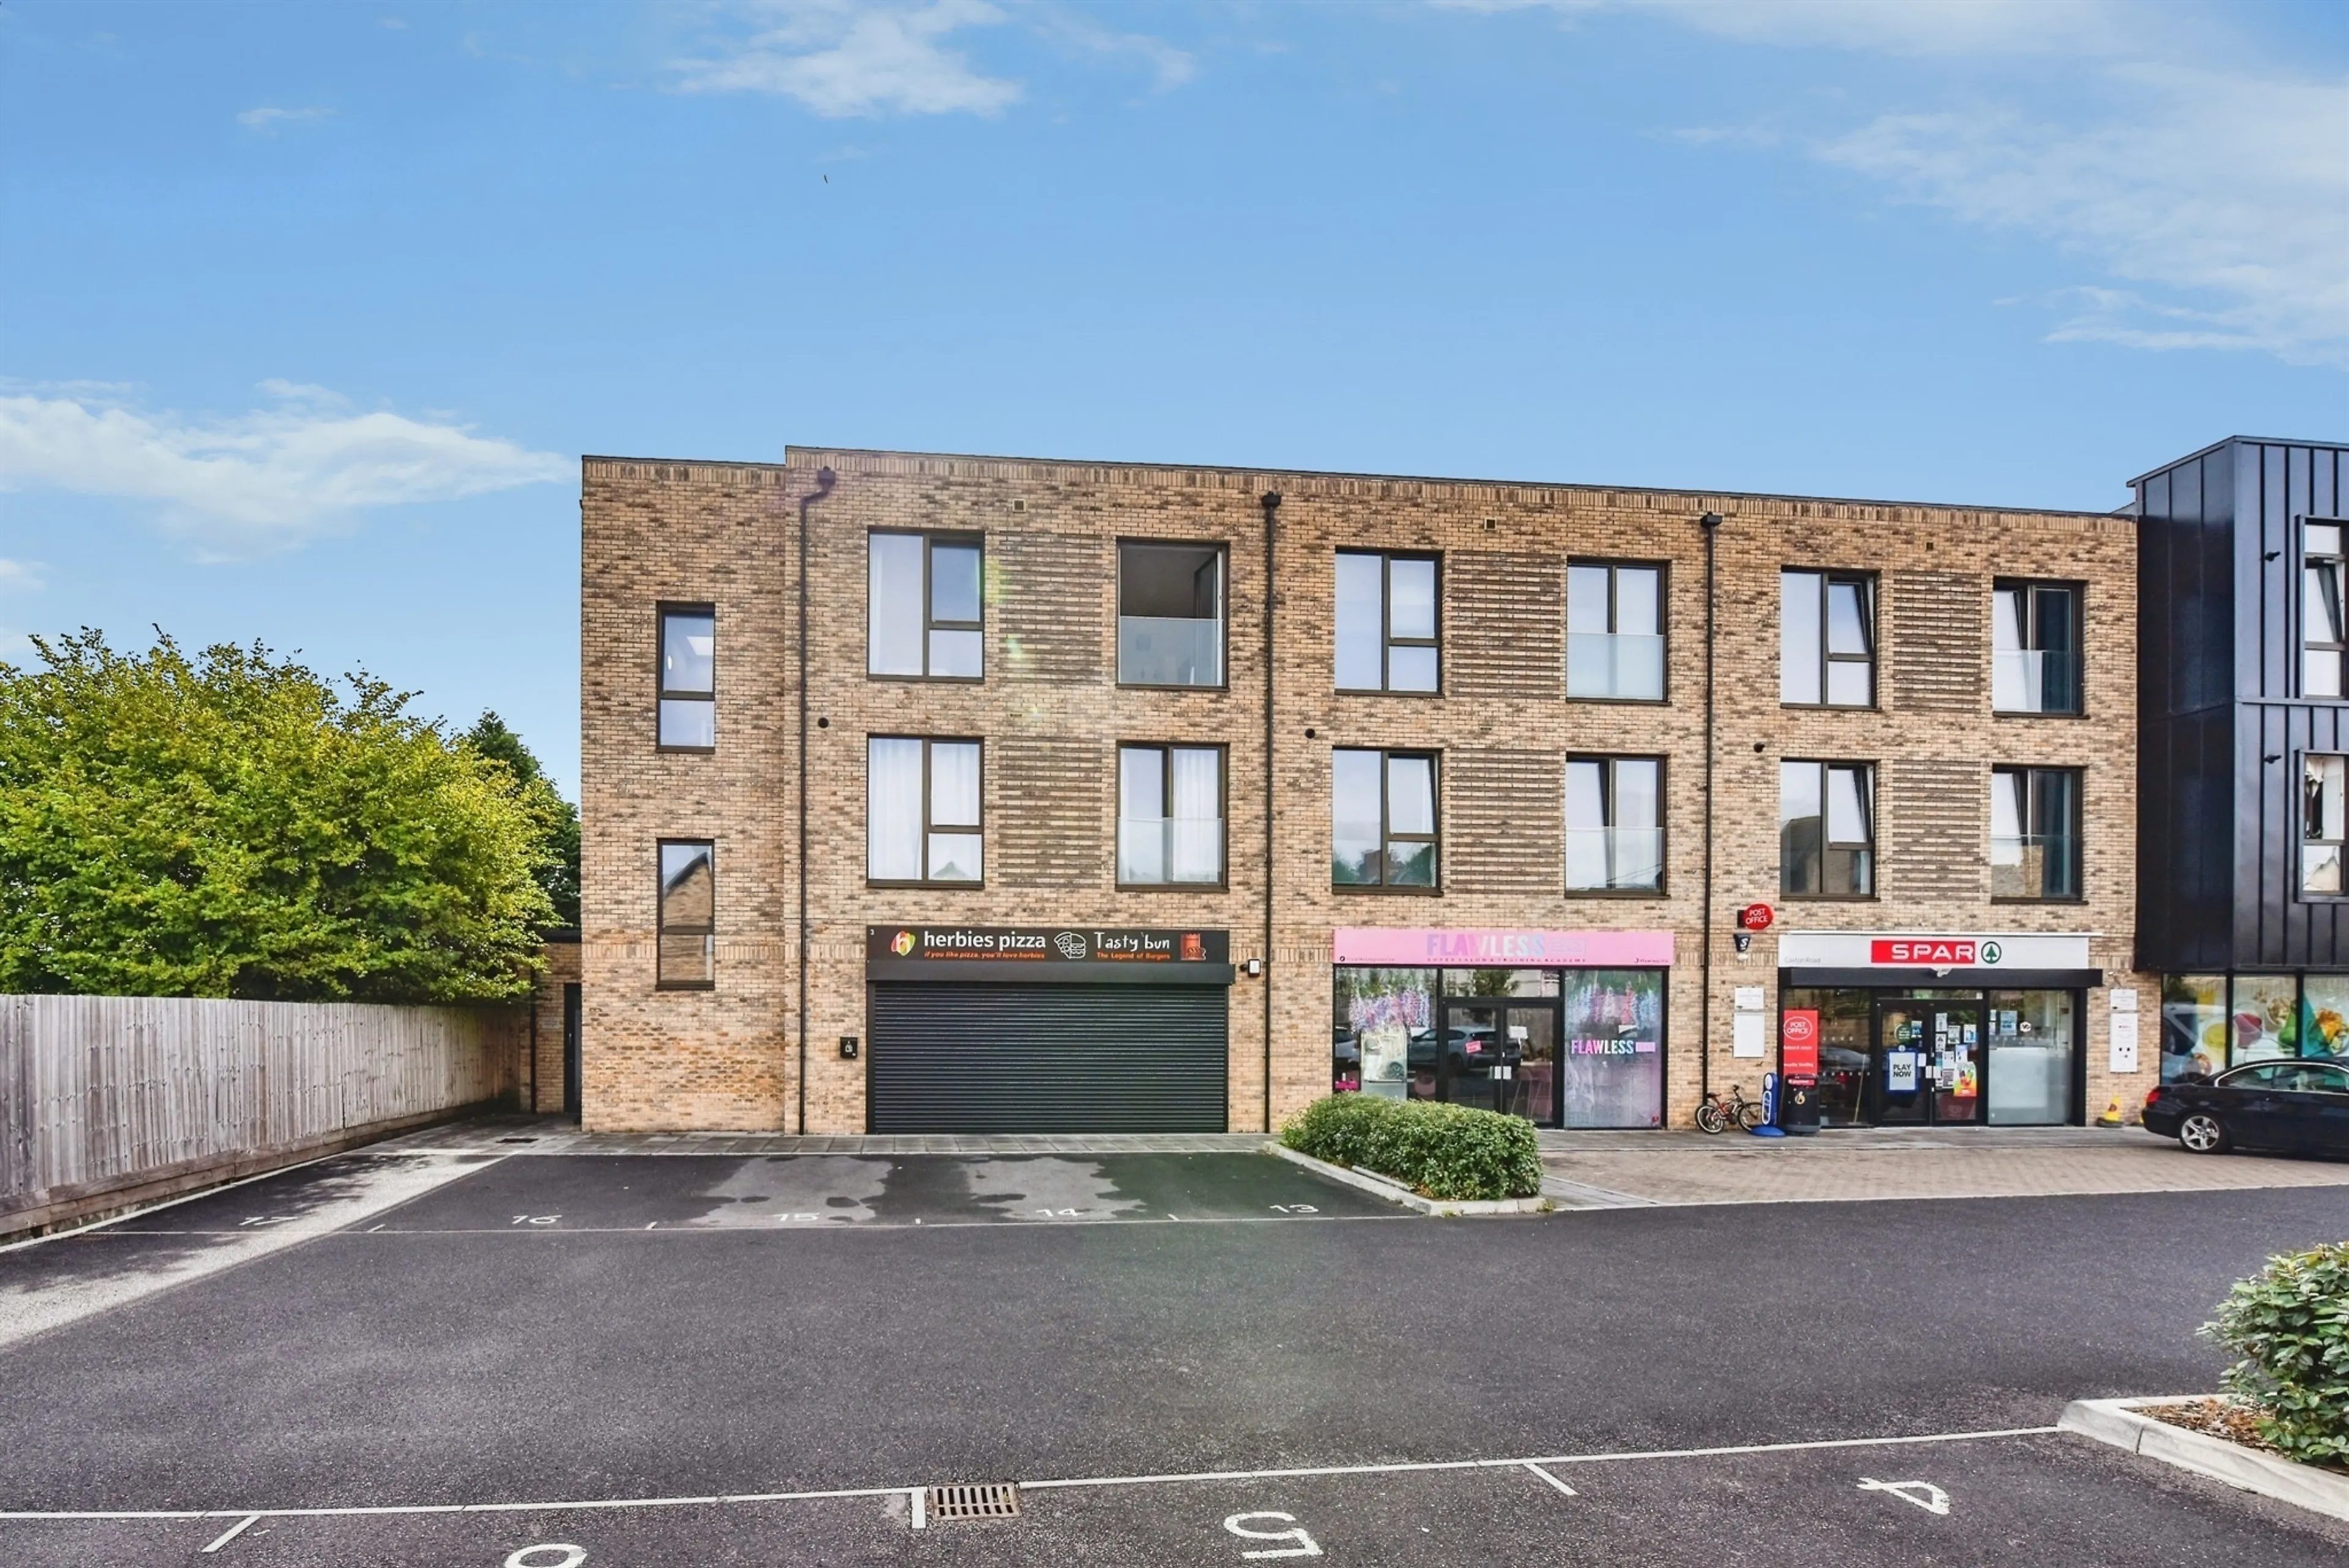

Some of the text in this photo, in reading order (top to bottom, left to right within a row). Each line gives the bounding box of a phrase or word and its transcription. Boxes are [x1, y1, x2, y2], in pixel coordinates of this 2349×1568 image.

[1749, 908, 1766, 916] POST
[1745, 915, 1768, 924] OFFICE
[924, 931, 1046, 951] herbies pizza
[1094, 932, 1138, 952] Tasty
[1427, 934, 1545, 957] FLAWLESS
[1145, 952, 1171, 960] Burgers
[1891, 943, 1973, 960] SPAR
[1571, 1039, 1634, 1054] FLAWLESS
[1035, 1208, 1085, 1217] 14
[1269, 1204, 1319, 1213] 13
[511, 1214, 562, 1225] 16
[772, 1213, 820, 1222] 15
[1223, 1511, 1324, 1559] 5
